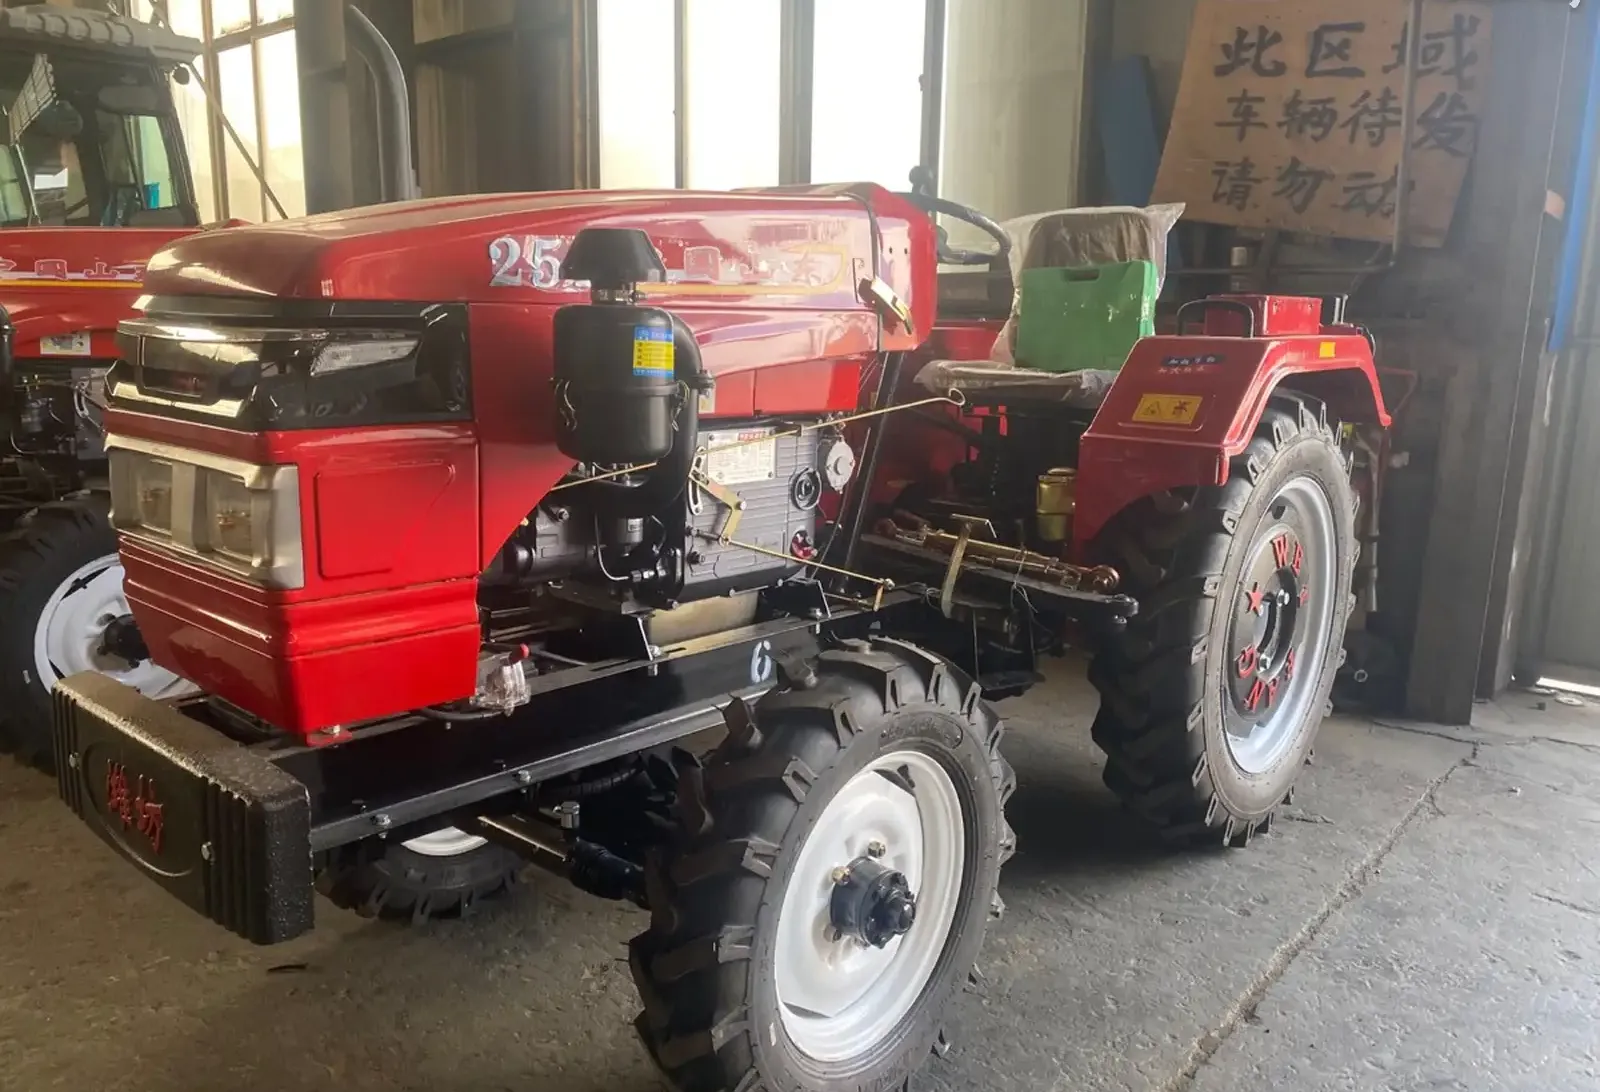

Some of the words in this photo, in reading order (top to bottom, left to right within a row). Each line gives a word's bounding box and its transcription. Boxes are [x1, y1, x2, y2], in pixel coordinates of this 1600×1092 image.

[1213, 14, 1480, 91] 此区域
[1213, 86, 1479, 157] 车辆待发
[1211, 156, 1416, 218] 请勿动
[751, 640, 772, 683] 6
